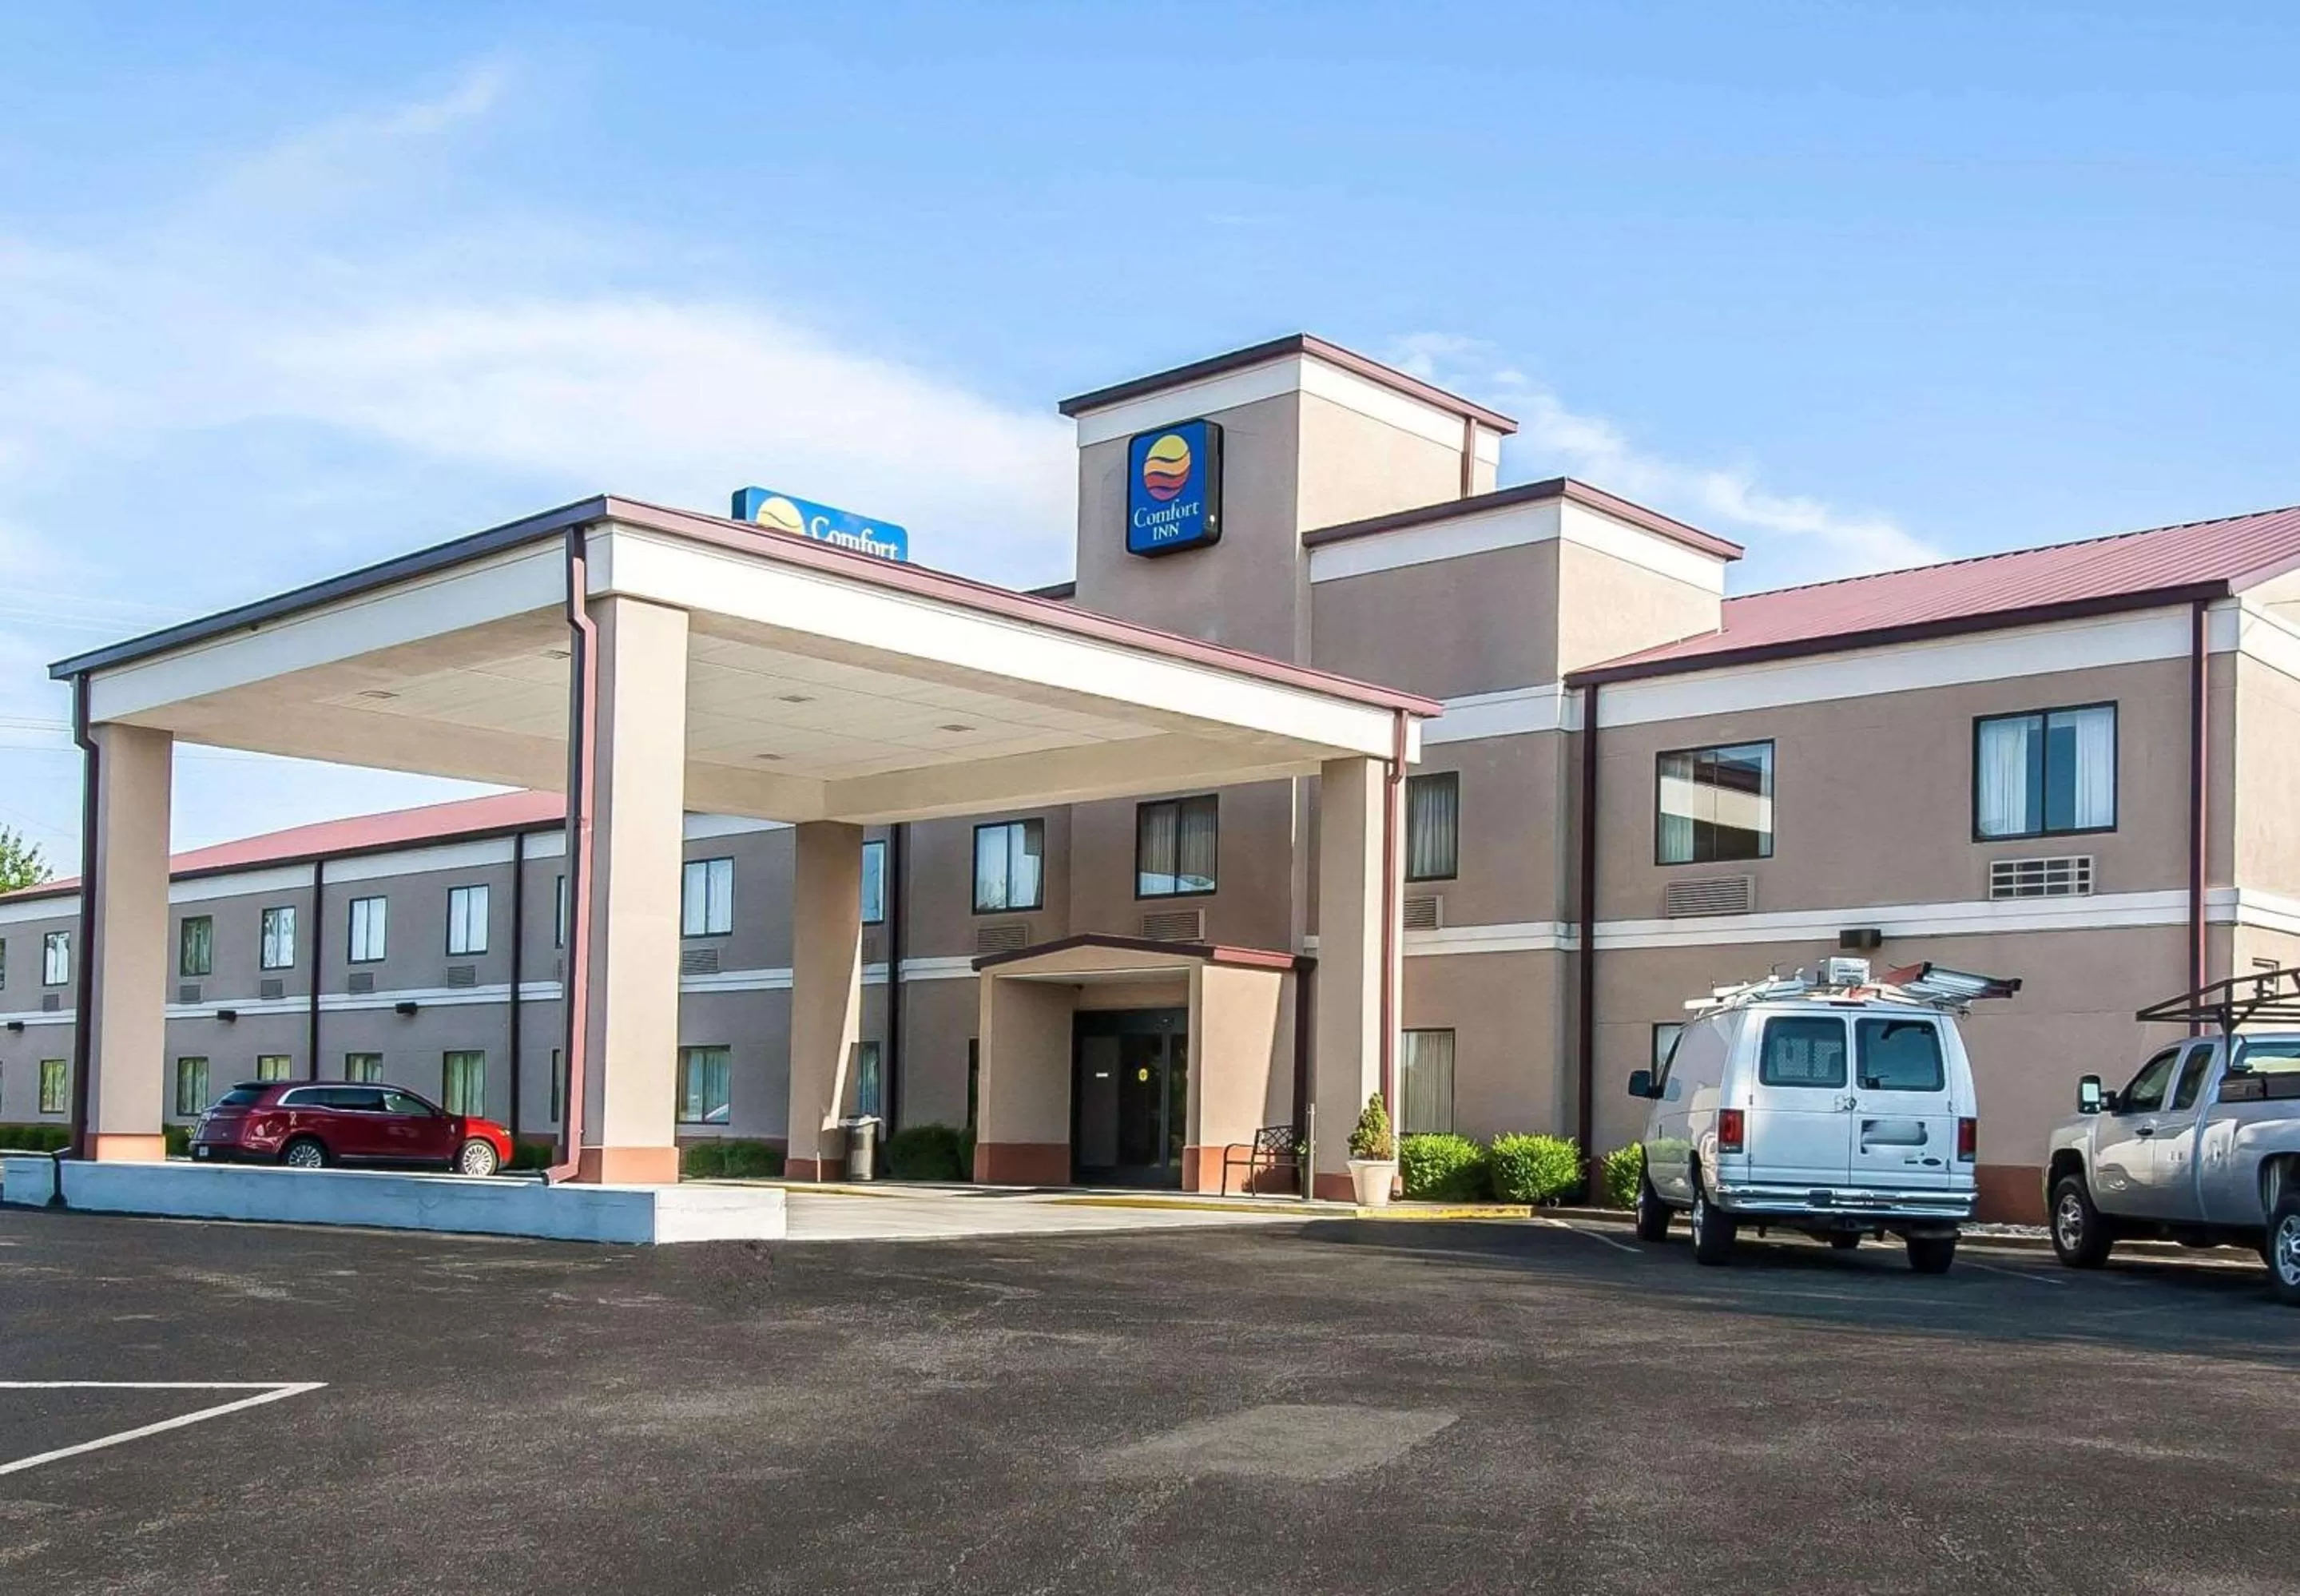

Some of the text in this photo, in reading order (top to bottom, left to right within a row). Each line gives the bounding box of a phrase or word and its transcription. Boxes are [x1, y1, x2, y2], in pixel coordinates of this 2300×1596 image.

[1134, 498, 1200, 528] Comfort
[811, 516, 898, 560] Comfort
[1153, 522, 1179, 541] INN
